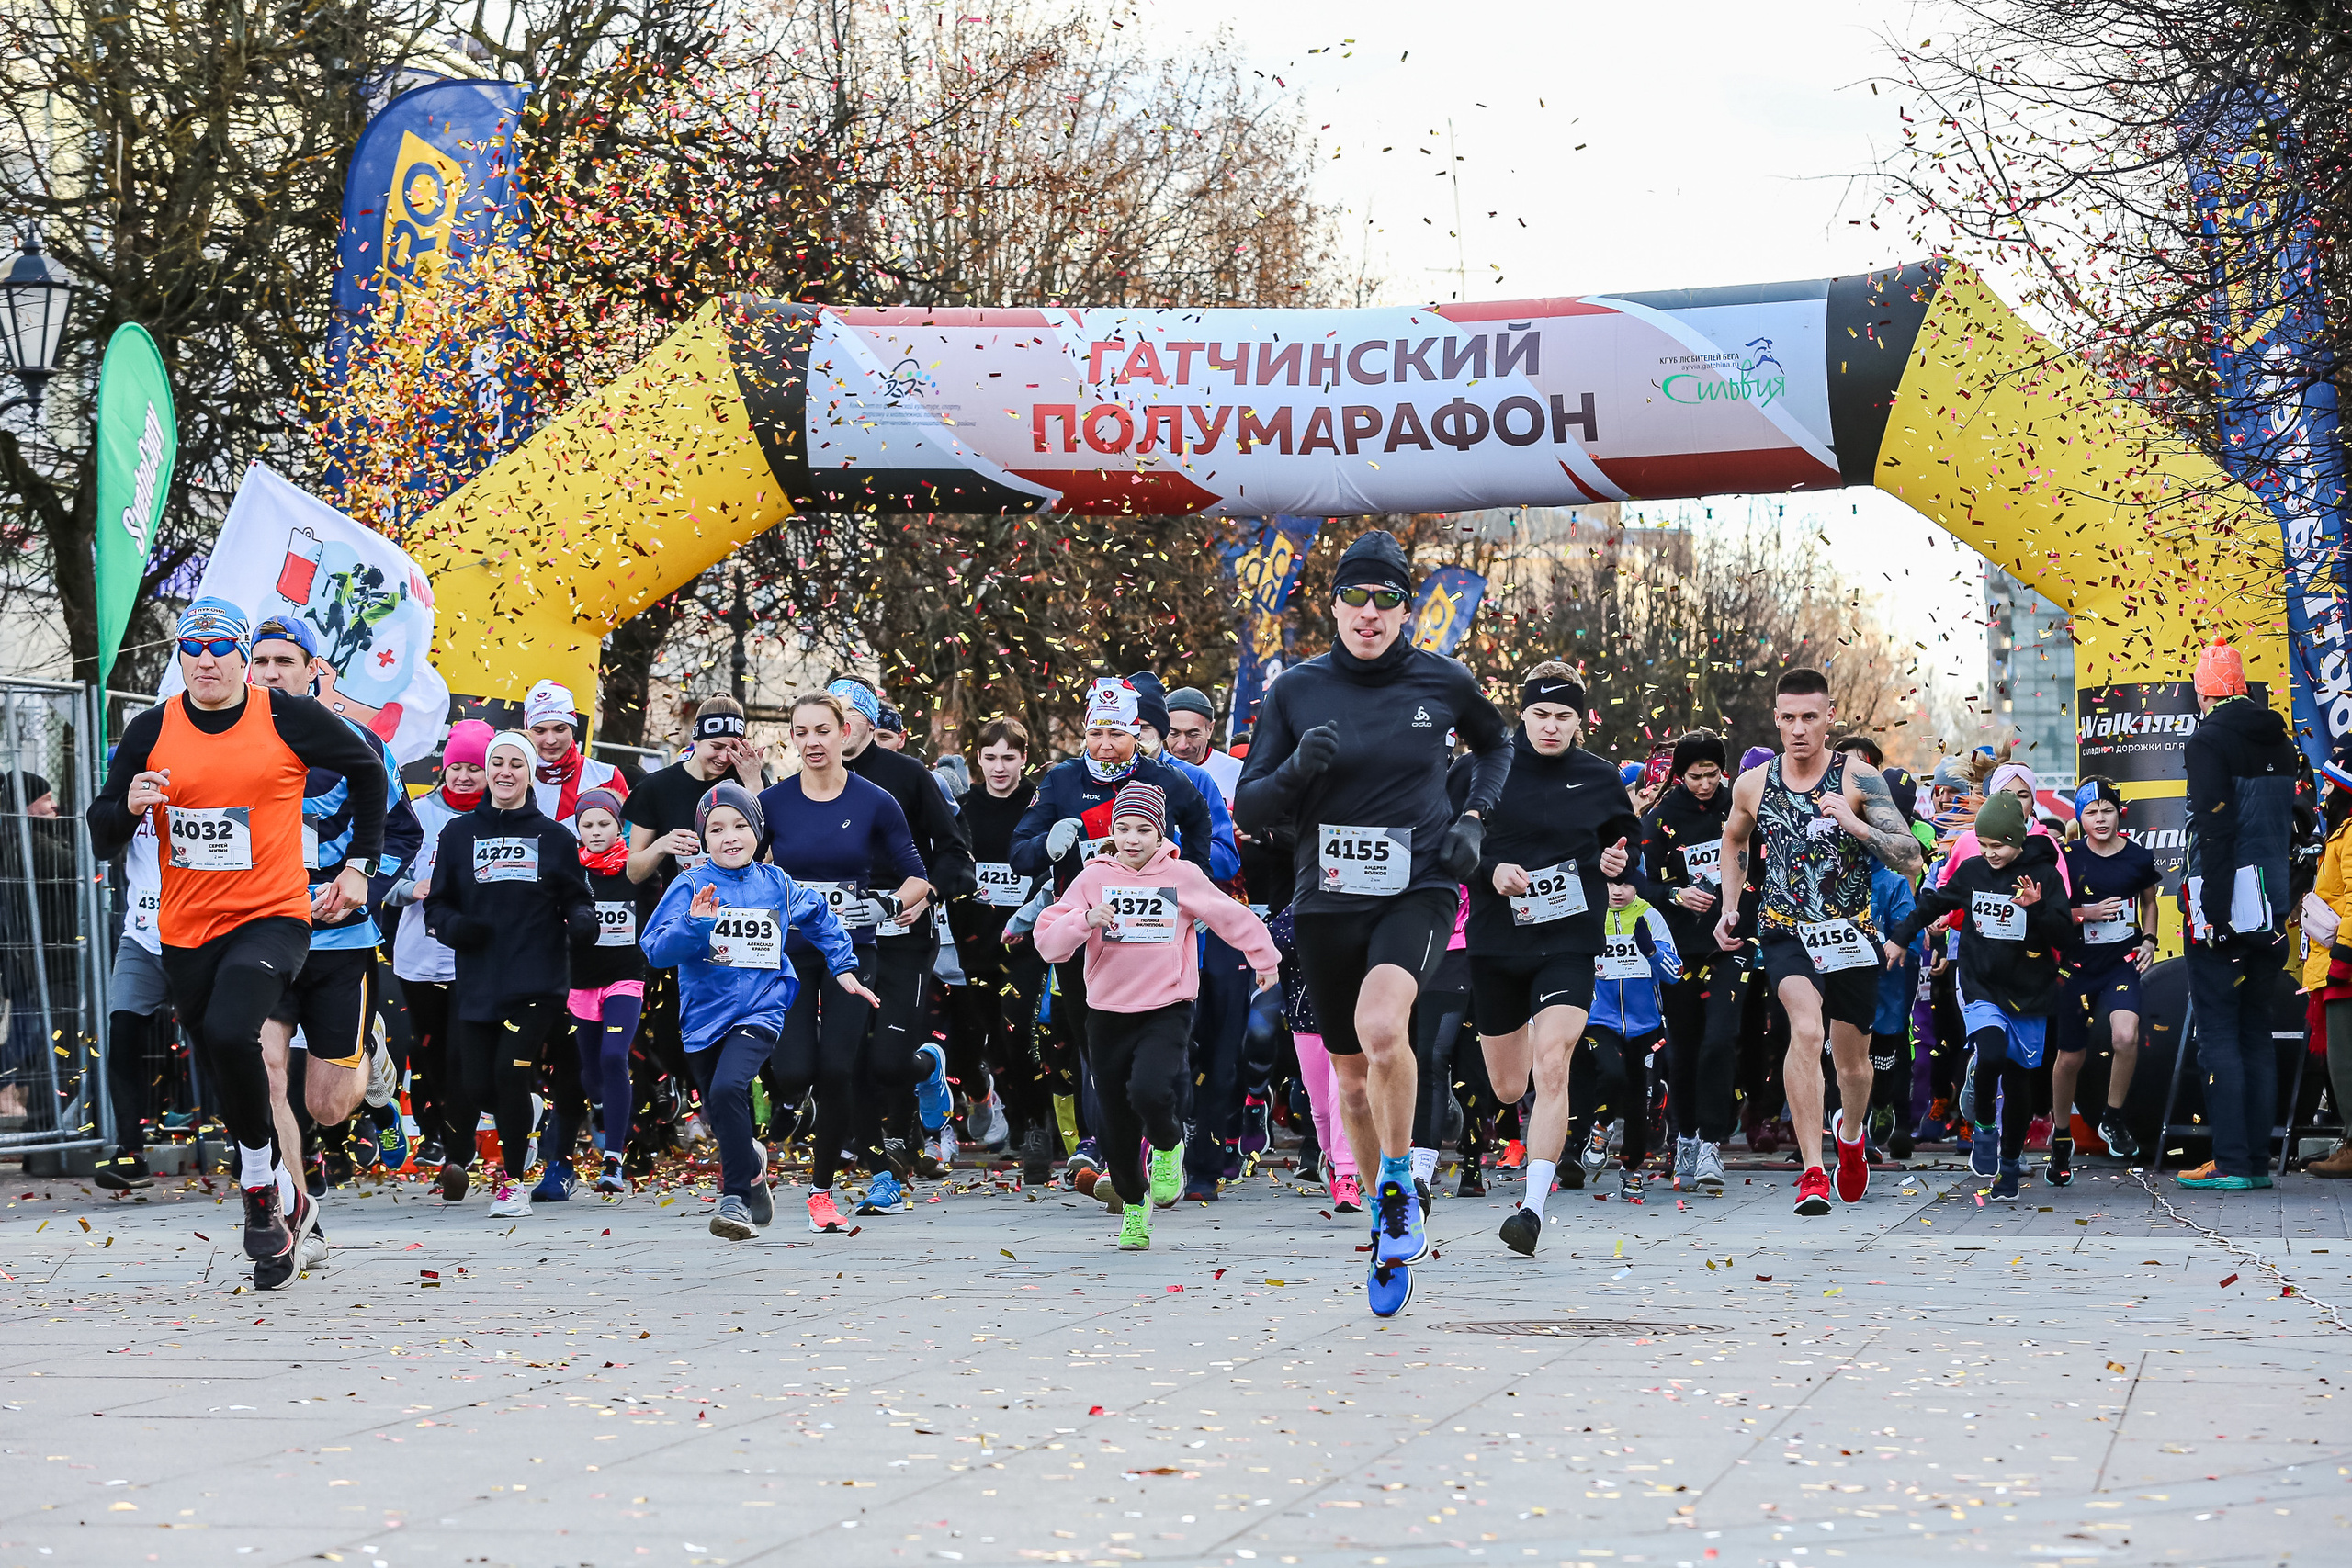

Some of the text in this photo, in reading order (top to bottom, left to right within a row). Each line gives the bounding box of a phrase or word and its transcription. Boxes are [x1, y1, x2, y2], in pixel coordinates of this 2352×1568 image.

[1088, 321, 1542, 386] ГАТЧИНСКИЙ
[1679, 353, 1722, 364] ЛЮБИТЕЛЕЙ
[1681, 362, 1740, 371] sylvia.gatchina.ru
[1662, 359, 1785, 408] Сильвия
[1033, 392, 1599, 456] ПОЛУМАРАФОН
[2080, 710, 2201, 739] Walking
[2116, 742, 2162, 754] дорожки
[2165, 741, 2186, 751] для
[172, 820, 233, 840] 4032
[476, 846, 526, 860] 4279
[1325, 839, 1390, 862] 4155
[1688, 848, 1720, 866] 407
[979, 871, 1021, 885] 4219
[1513, 874, 1566, 899] 192
[1109, 897, 1163, 915] 4372
[1973, 901, 2015, 918] 4259
[595, 910, 628, 924] 209
[715, 919, 773, 939] 4193
[1806, 927, 1859, 949] 4156
[1600, 943, 1638, 958] 291
